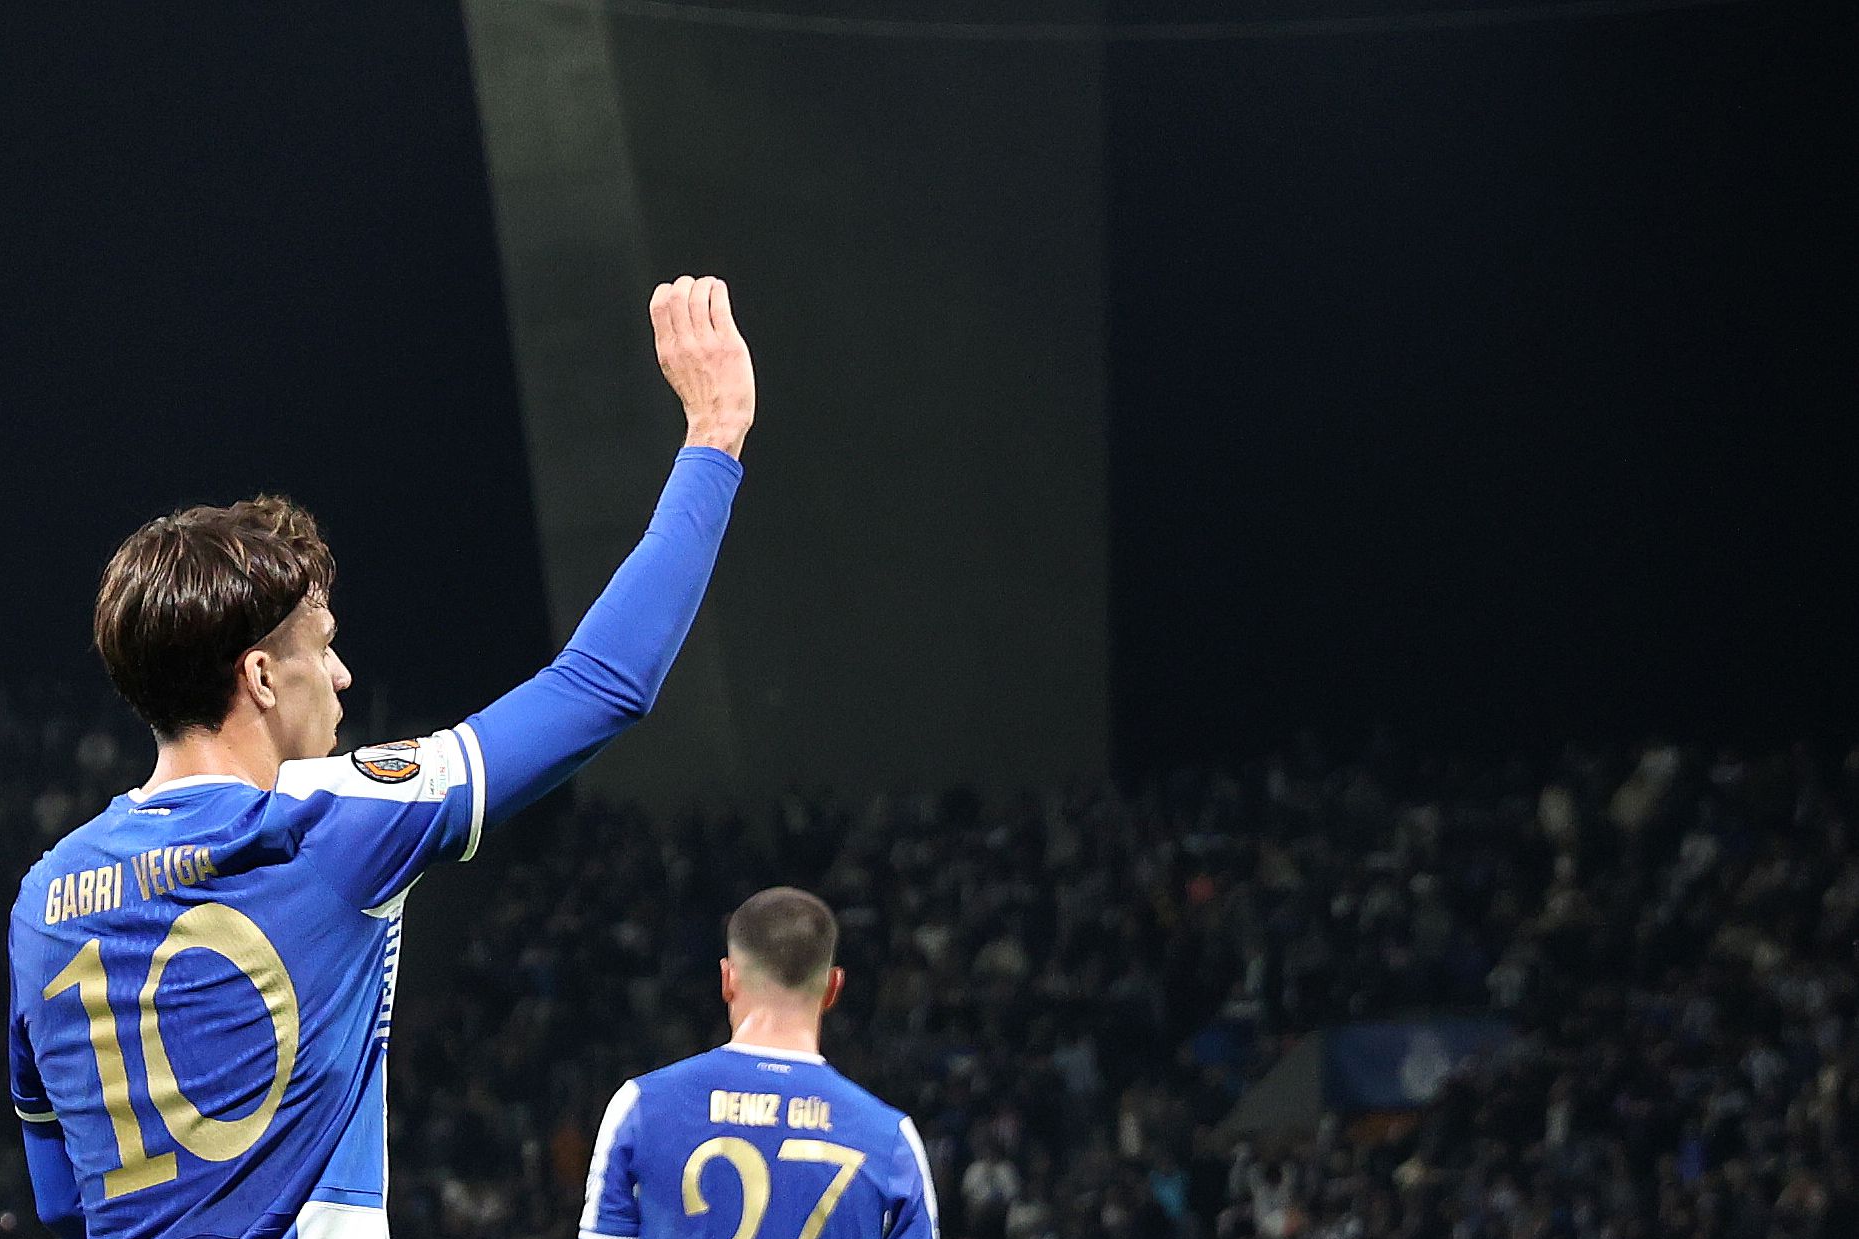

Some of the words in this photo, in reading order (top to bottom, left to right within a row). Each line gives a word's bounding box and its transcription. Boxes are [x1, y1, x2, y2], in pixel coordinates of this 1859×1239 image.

[44, 862, 123, 925] GABRI
[131, 844, 219, 901] VEIGA
[43, 902, 300, 1199] 10
[709, 1089, 782, 1127] DENIZ
[787, 1095, 834, 1133] GÜL
